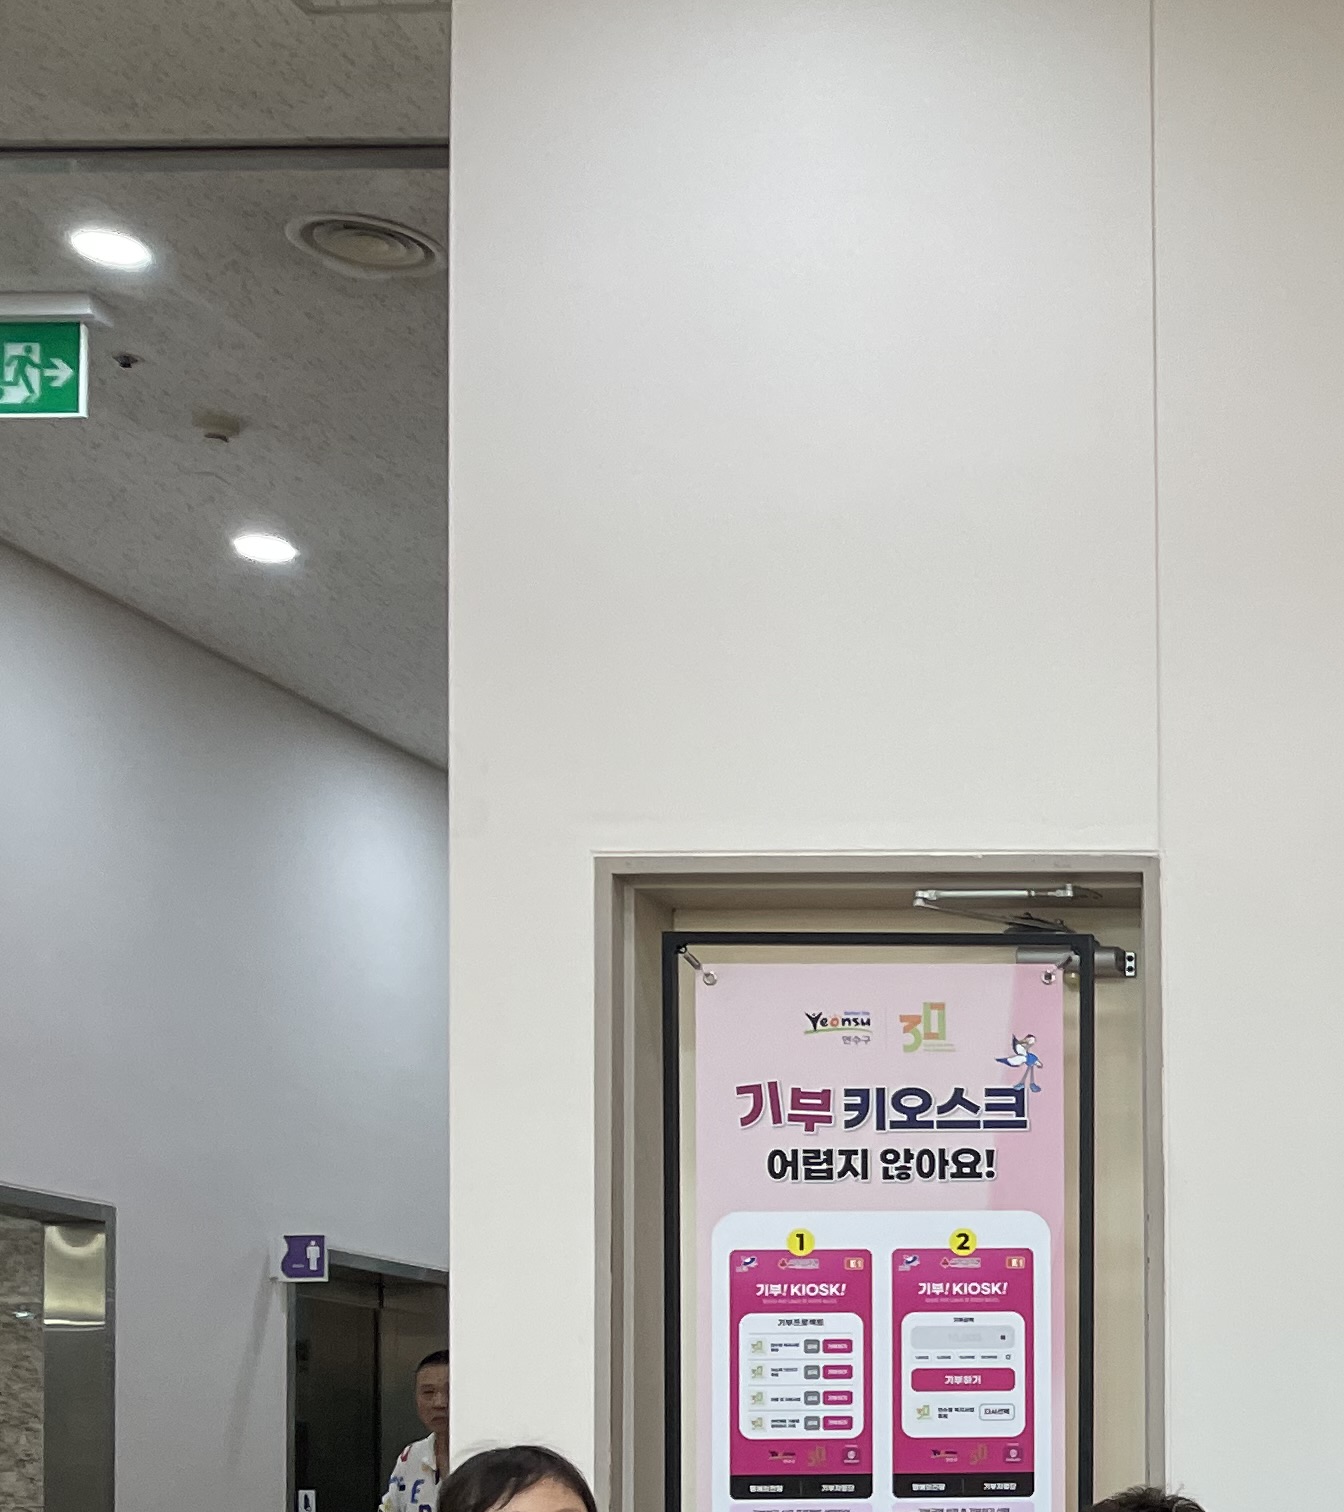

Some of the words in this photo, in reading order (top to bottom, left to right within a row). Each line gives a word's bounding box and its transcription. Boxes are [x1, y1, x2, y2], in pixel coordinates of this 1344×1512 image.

[804, 1011, 871, 1032] Yeonsu
[736, 1080, 833, 1133] 기부
[843, 1086, 1028, 1132] 키오스크
[766, 1148, 868, 1181] 어렵지
[879, 1148, 995, 1181] 않아요!
[795, 1233, 805, 1250] 1
[956, 1233, 970, 1250] 2
[756, 1283, 787, 1296] 기부!
[790, 1283, 846, 1296] KIOSK!
[918, 1282, 949, 1295] 기부!
[952, 1282, 1008, 1295] KIOSK!
